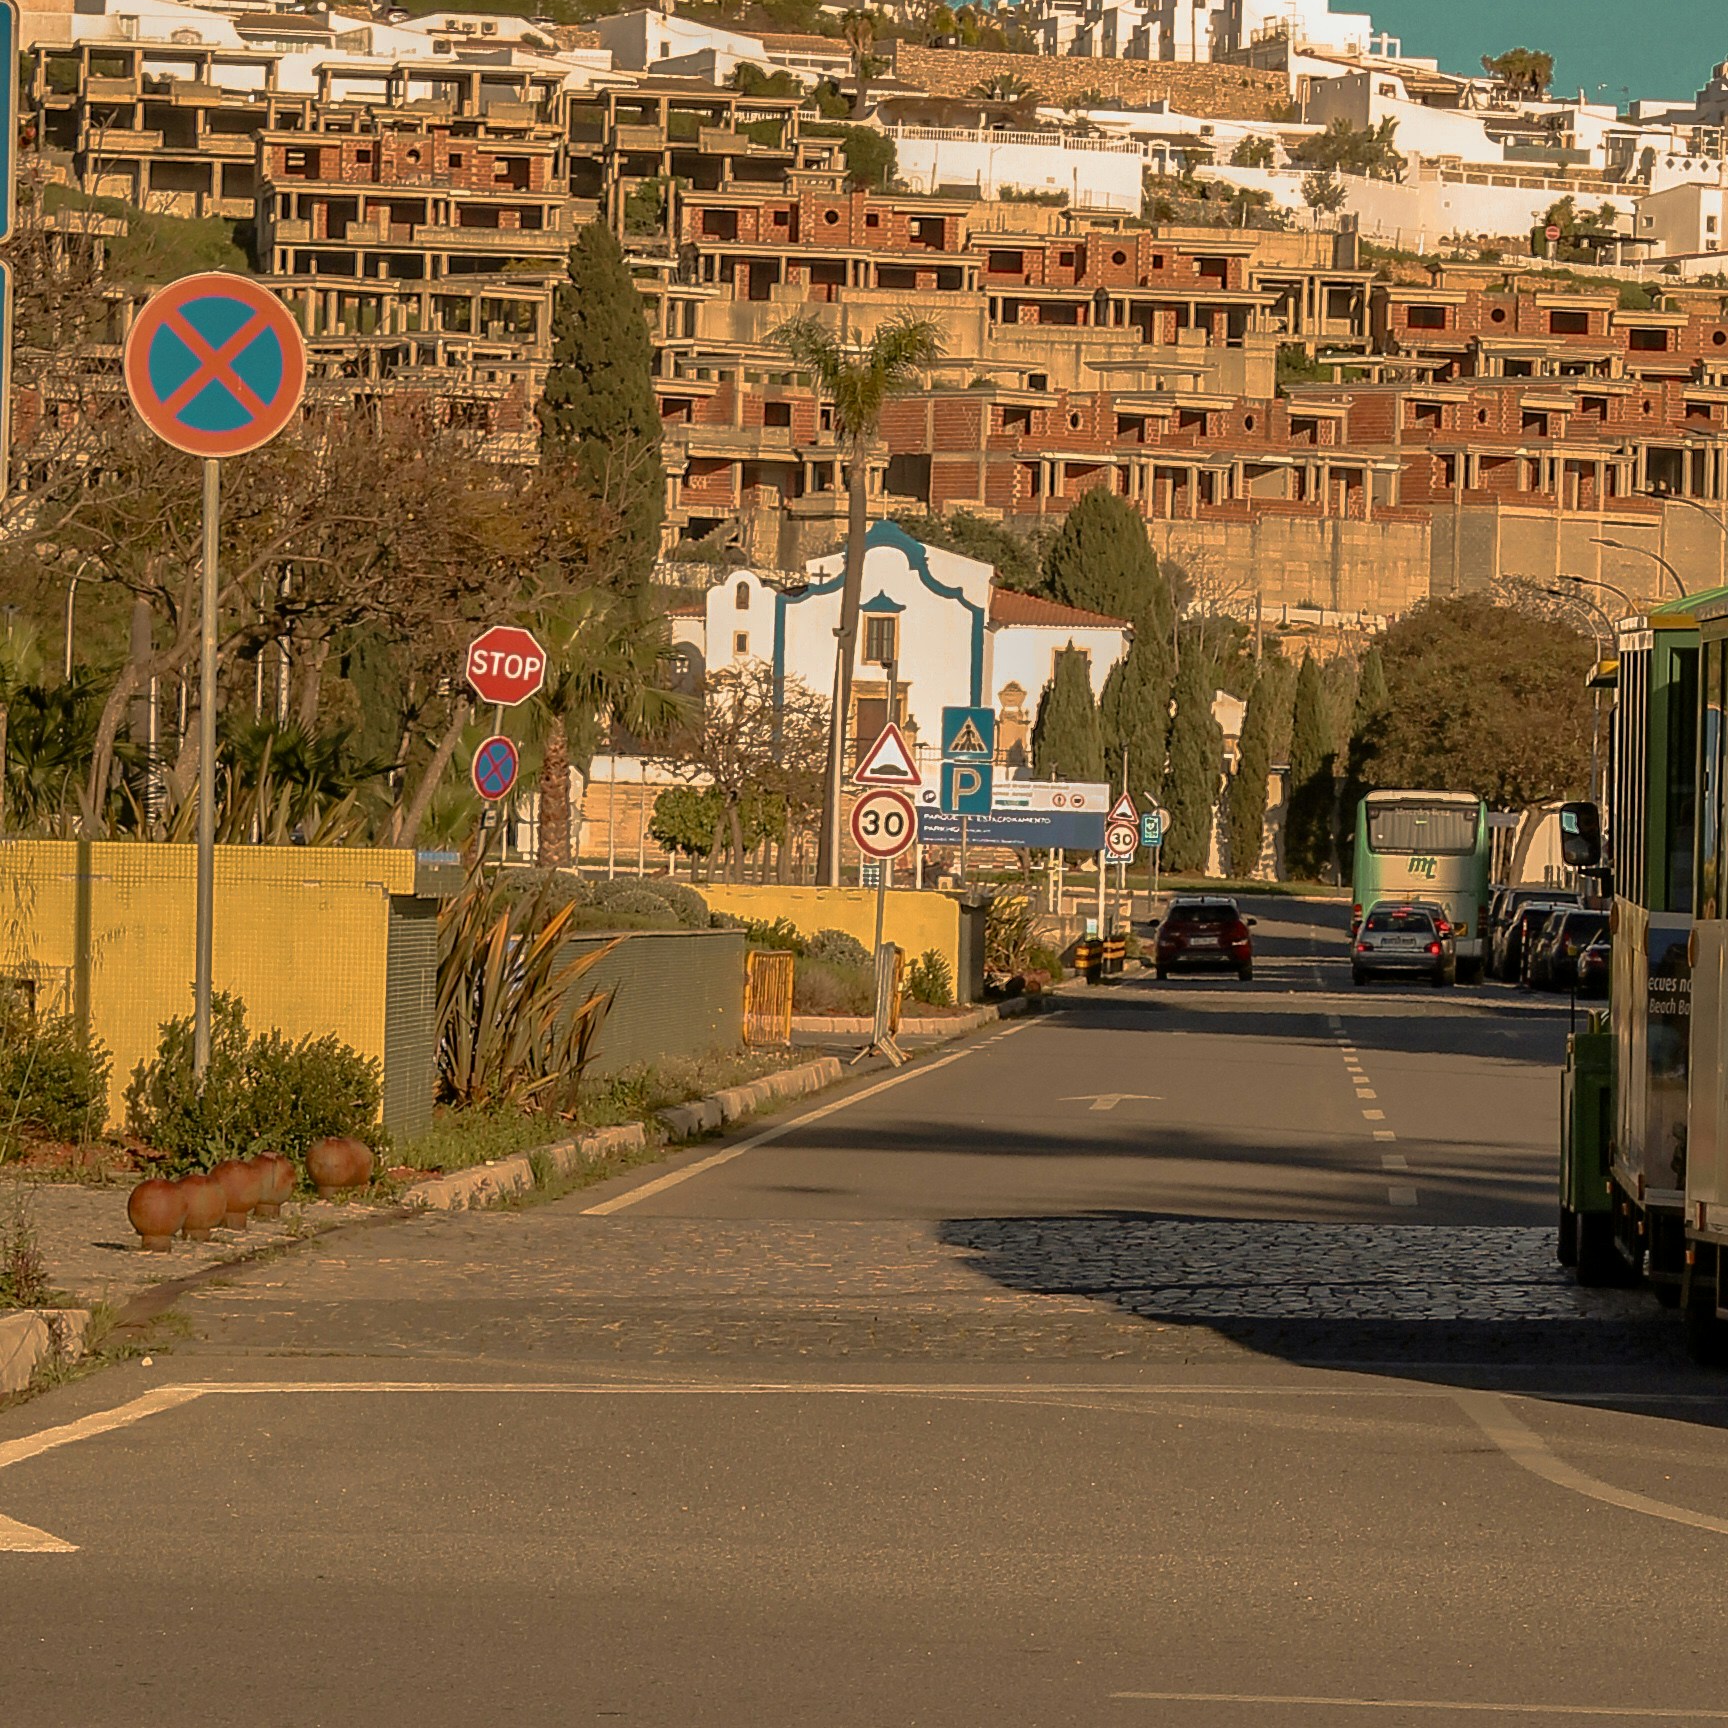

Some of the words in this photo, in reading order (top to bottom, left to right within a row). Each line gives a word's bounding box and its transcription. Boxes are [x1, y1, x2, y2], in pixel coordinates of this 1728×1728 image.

[472, 649, 540, 680] STOP
[952, 768, 981, 811] P
[862, 810, 904, 837] 30
[1112, 833, 1132, 846] 30
[1649, 997, 1676, 1014] Beach
